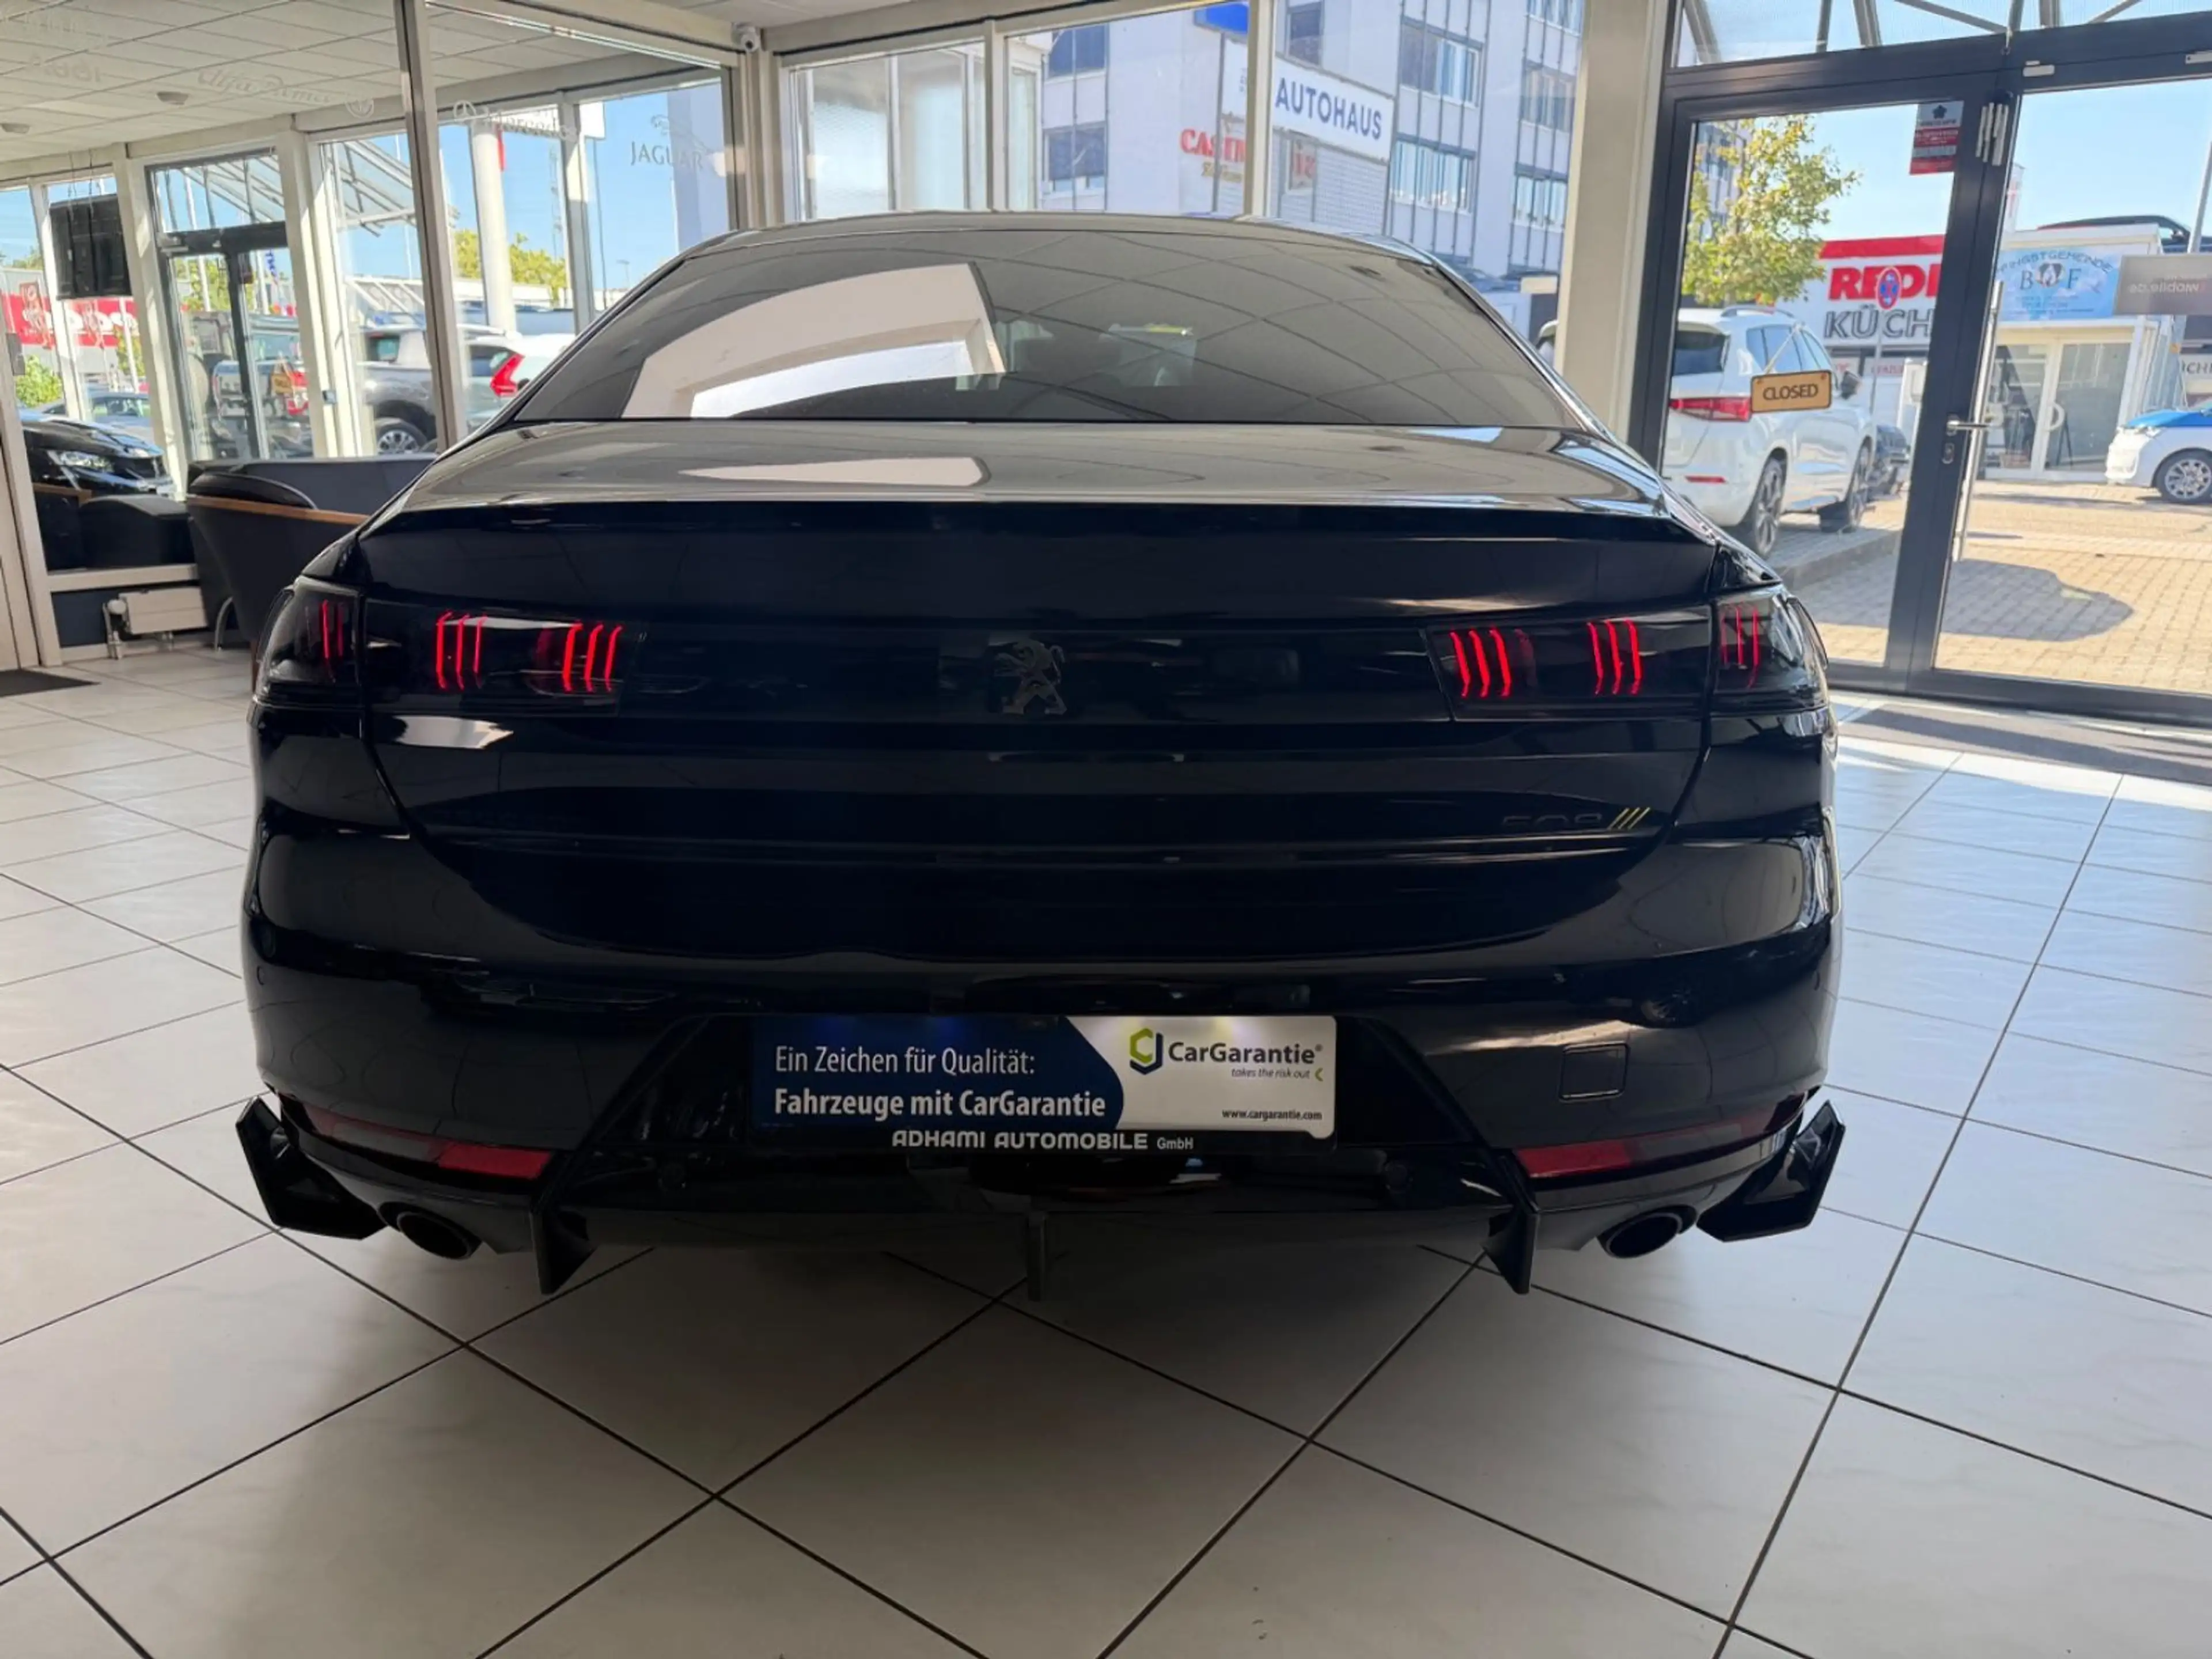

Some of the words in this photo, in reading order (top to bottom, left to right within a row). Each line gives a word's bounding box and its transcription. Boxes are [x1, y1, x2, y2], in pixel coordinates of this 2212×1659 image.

[1275, 77, 1381, 141] AUTOHAUS
[630, 140, 704, 169] JAGUAR
[1763, 383, 1819, 400] CLOSED
[776, 1046, 808, 1072] Ein
[814, 1046, 899, 1073] Zeichen
[904, 1047, 936, 1073] für
[941, 1047, 1035, 1076] Qualität:
[1231, 1067, 1256, 1077] takes
[1258, 1067, 1274, 1077] the
[1274, 1067, 1292, 1078] risk
[1293, 1069, 1310, 1079] out
[775, 1088, 904, 1122] Fahrzeuge
[910, 1089, 953, 1116] mit
[959, 1090, 1105, 1117] CarGarantie
[1222, 1109, 1323, 1121] www.cargarantie.com
[892, 1130, 984, 1148] ADHAMI
[994, 1132, 1149, 1150] AUTOMOBILE
[1157, 1137, 1194, 1150] GmbH
